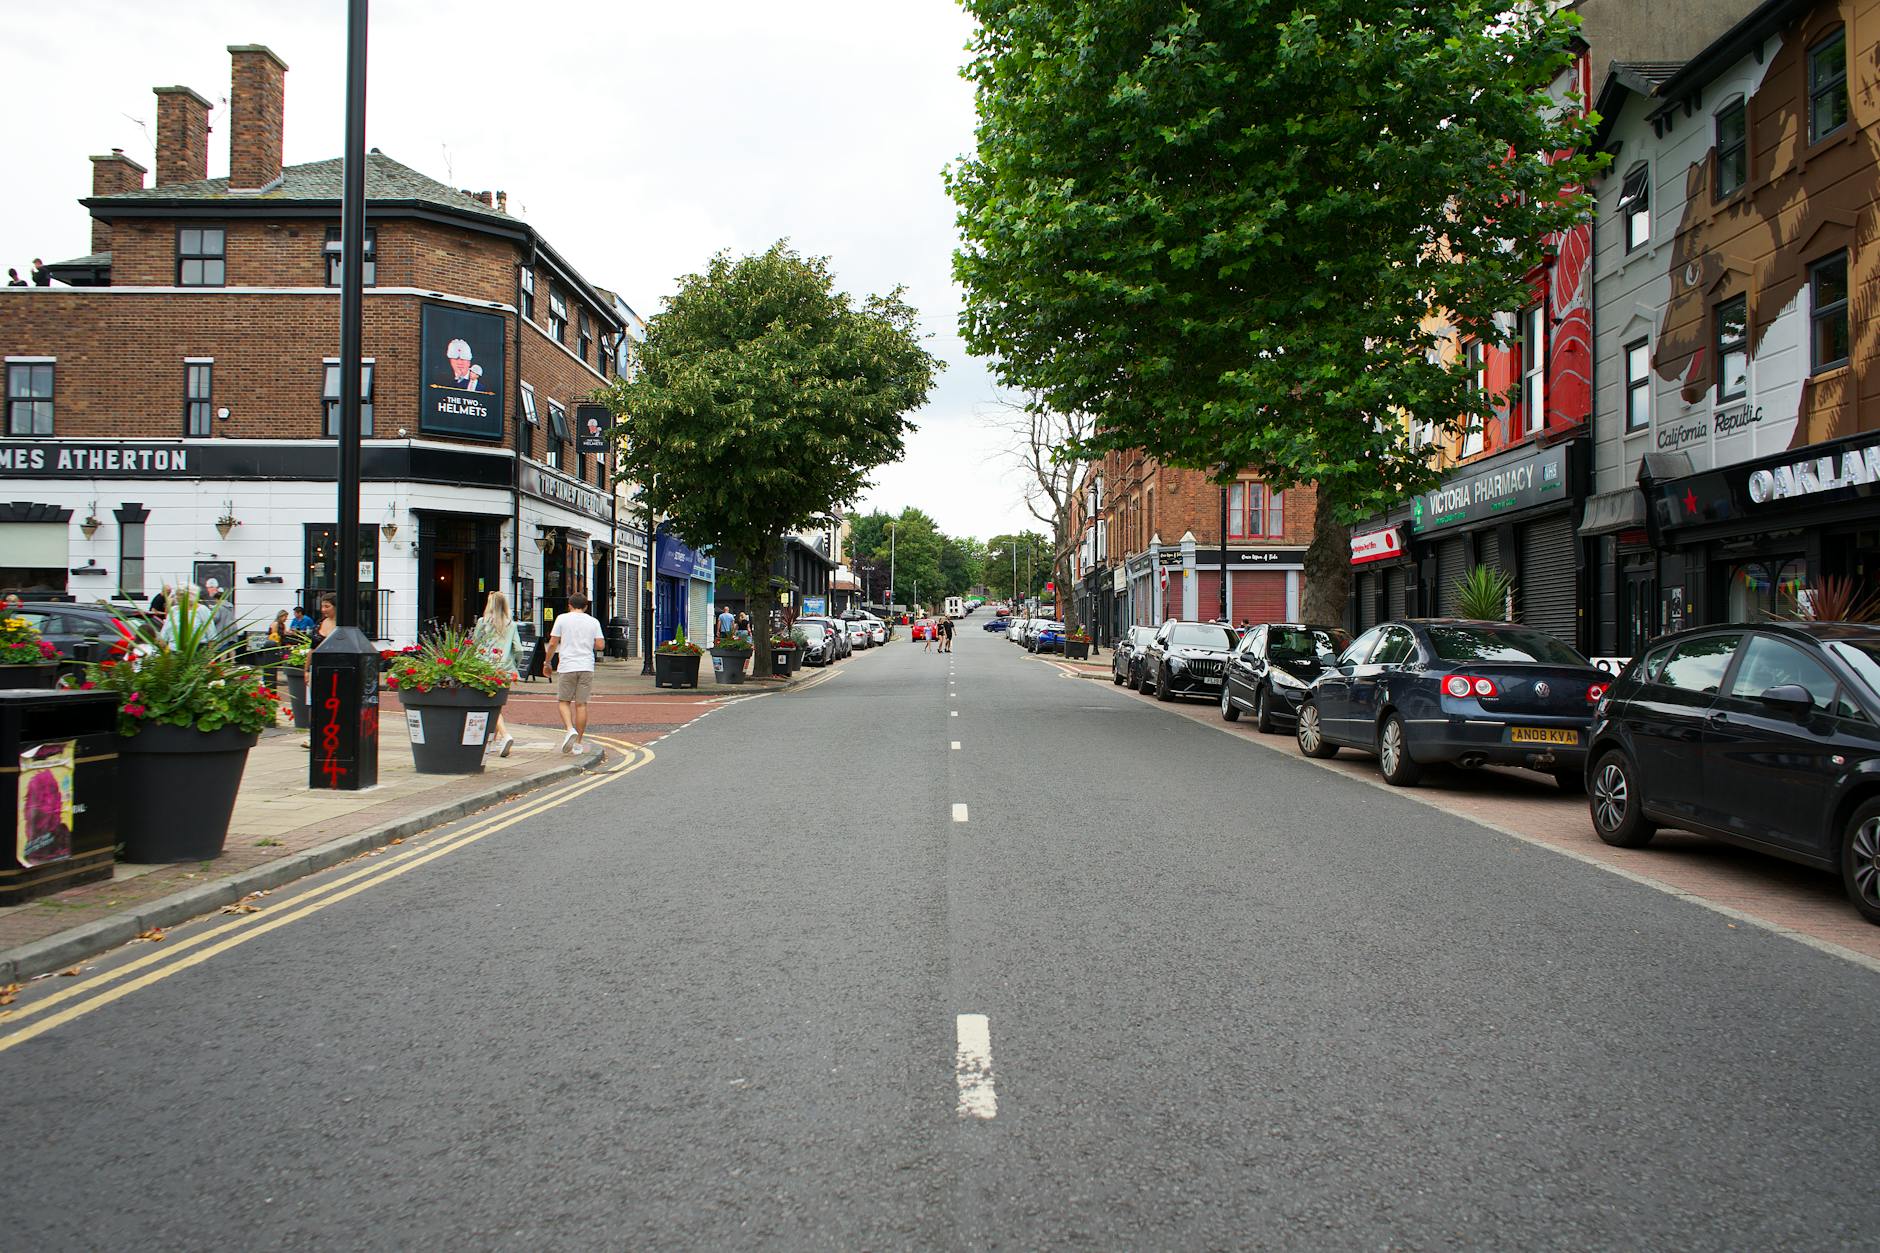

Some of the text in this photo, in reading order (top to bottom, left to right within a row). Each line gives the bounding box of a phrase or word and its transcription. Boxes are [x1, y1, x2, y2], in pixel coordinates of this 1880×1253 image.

[438, 402, 488, 417] HELMETS
[446, 396, 478, 407] THE TWO
[1657, 404, 1763, 450] California Republic
[57, 449, 187, 470] ATHERTON
[540, 475, 554, 496] THE
[555, 480, 576, 504] JAMES
[1430, 485, 1470, 515] VICTORIA
[1474, 464, 1534, 503] PHARMACY
[1544, 463, 1558, 481] NHS
[322, 671, 348, 790] 1984
[1516, 730, 1573, 742] AN08 KVA
